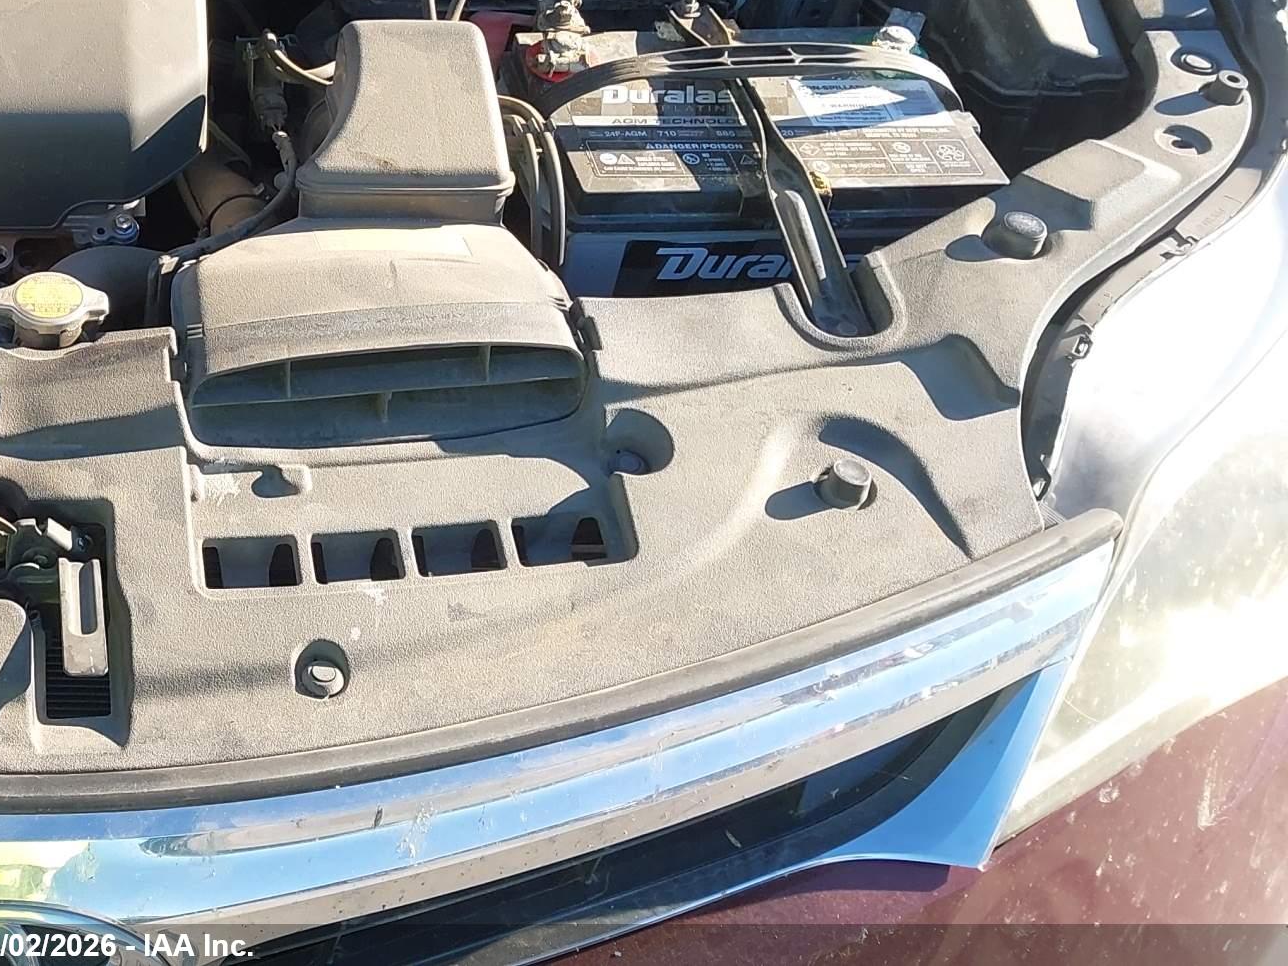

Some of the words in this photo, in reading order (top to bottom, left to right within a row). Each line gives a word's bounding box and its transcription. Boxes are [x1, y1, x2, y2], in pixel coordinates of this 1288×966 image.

[603, 85, 733, 104] Duralas
[654, 142, 745, 151] DANGER/POISON
[656, 246, 793, 280] Dural
